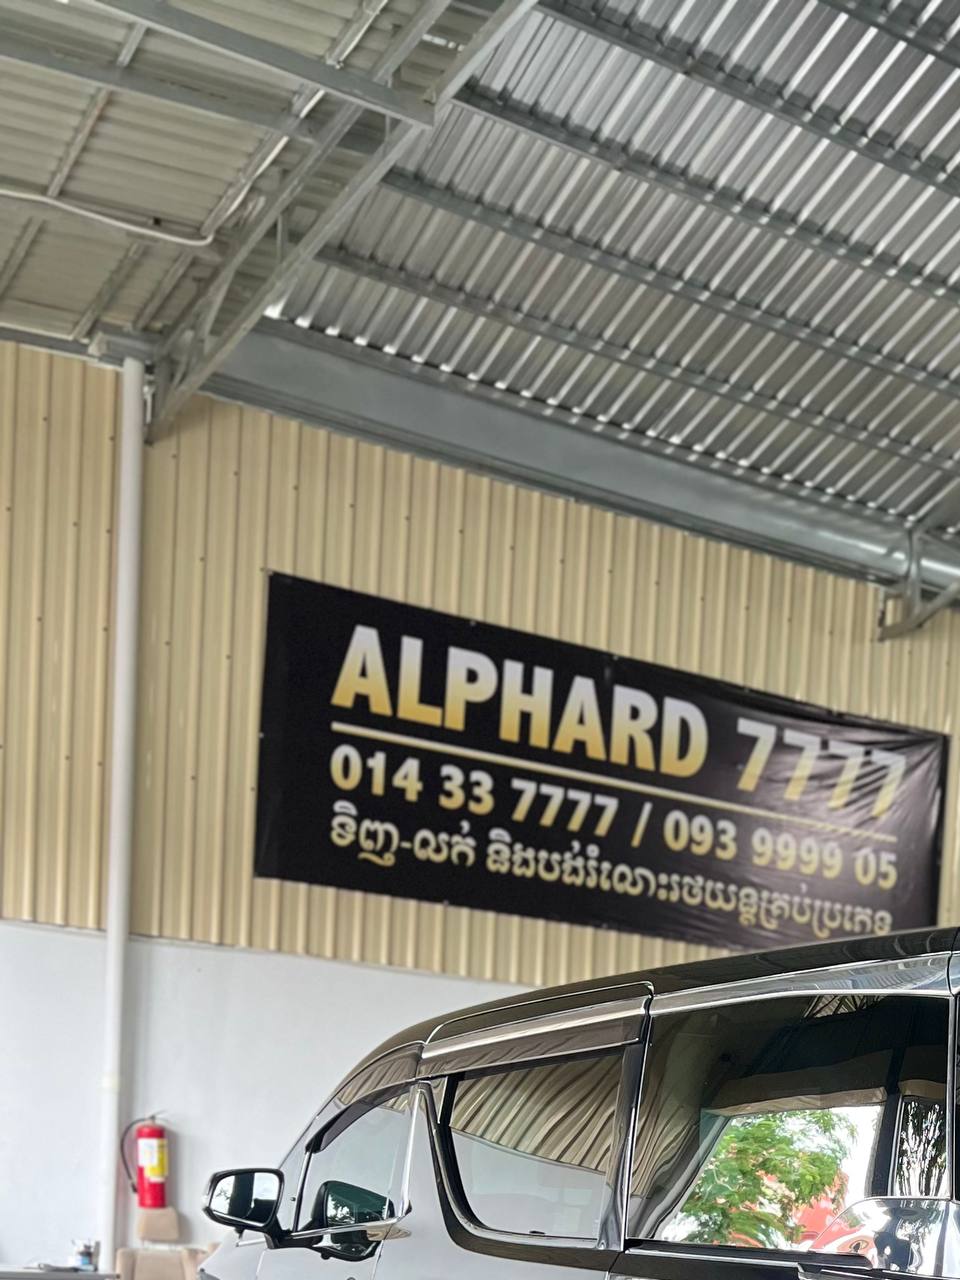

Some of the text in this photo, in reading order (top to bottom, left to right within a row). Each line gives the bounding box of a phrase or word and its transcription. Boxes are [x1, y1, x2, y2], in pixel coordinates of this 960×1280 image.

[330, 625, 908, 820] ALPHARD 7777
[330, 744, 898, 890] 014 33 7777 / 093 9999 05
